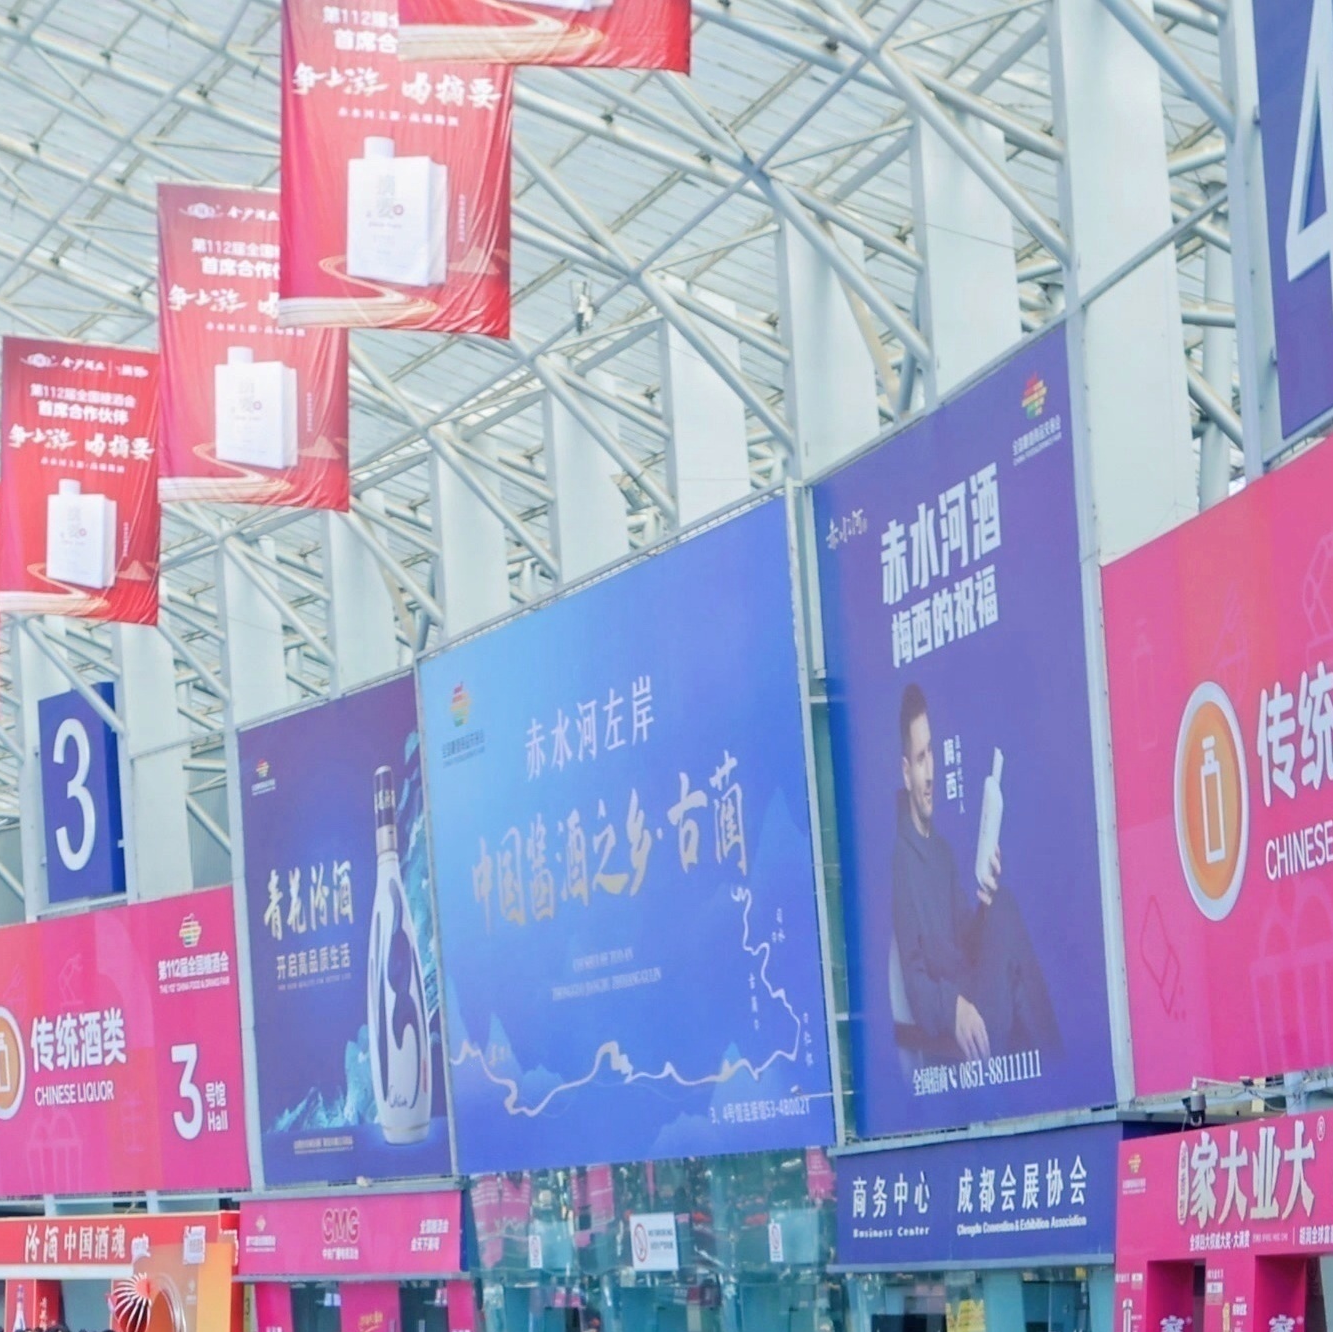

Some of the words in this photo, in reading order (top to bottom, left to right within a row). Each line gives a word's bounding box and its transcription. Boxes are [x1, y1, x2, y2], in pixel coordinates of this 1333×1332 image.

[293, 61, 388, 97] 争上游
[192, 238, 279, 259] 第112届全国
[880, 463, 1002, 605] 赤水河酒
[892, 563, 999, 668] 梅西的祝福
[525, 675, 655, 782] 赤水河左岸
[53, 716, 97, 871] 3
[264, 860, 354, 942] 青花汾酒
[158, 951, 229, 981] 第112届全国糖酒会
[276, 943, 351, 980] 开启高品质生活
[31, 1007, 127, 1073] 传统酒类
[35, 1086, 75, 1107] CHINESE
[77, 1080, 114, 1103] LIQUOR
[171, 1043, 203, 1140] 3
[913, 1063, 949, 1096] 全国招商
[959, 1050, 1042, 1090] 0851-88111111
[205, 1081, 226, 1108] 号馆
[207, 1110, 228, 1132] Hall
[852, 1170, 930, 1218] 商务中心
[957, 1154, 1087, 1214] 成都会展协会
[1189, 1119, 1315, 1230] 家大业大
[63, 1224, 126, 1261] 中国酒魂
[322, 1207, 360, 1244] CMG
[853, 1228, 893, 1238] Business
[898, 1226, 929, 1236] Center
